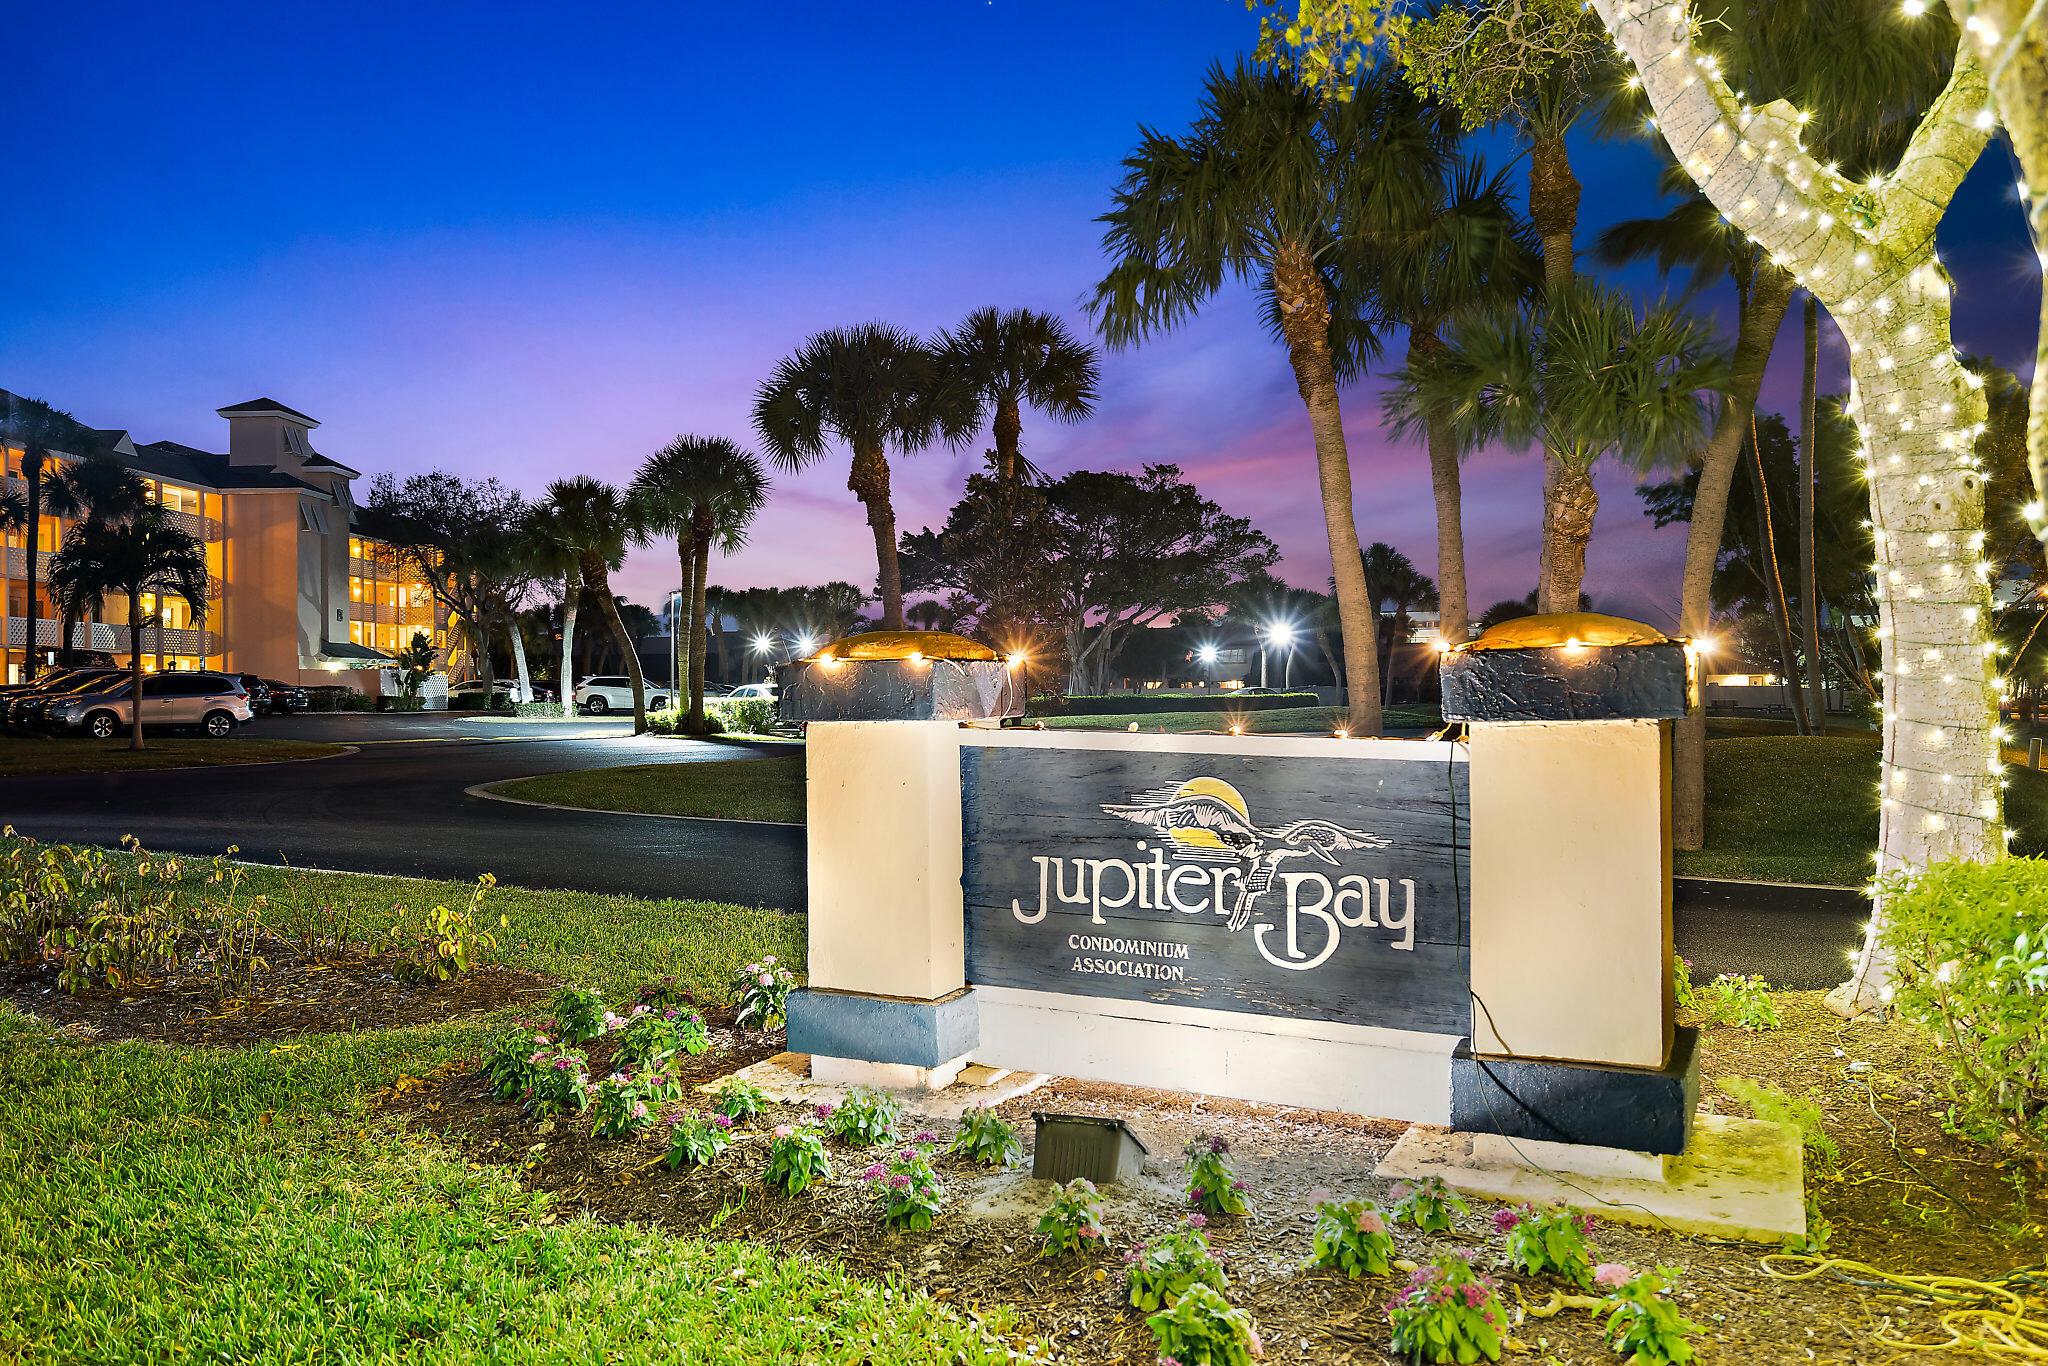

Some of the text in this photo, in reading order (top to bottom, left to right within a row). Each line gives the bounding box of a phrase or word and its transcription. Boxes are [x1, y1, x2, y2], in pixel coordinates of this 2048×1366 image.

[1012, 840, 1415, 971] Jupiter Bay
[1068, 934, 1190, 960] CONDOMINIUM
[1071, 956, 1185, 982] ASSOCIATION
